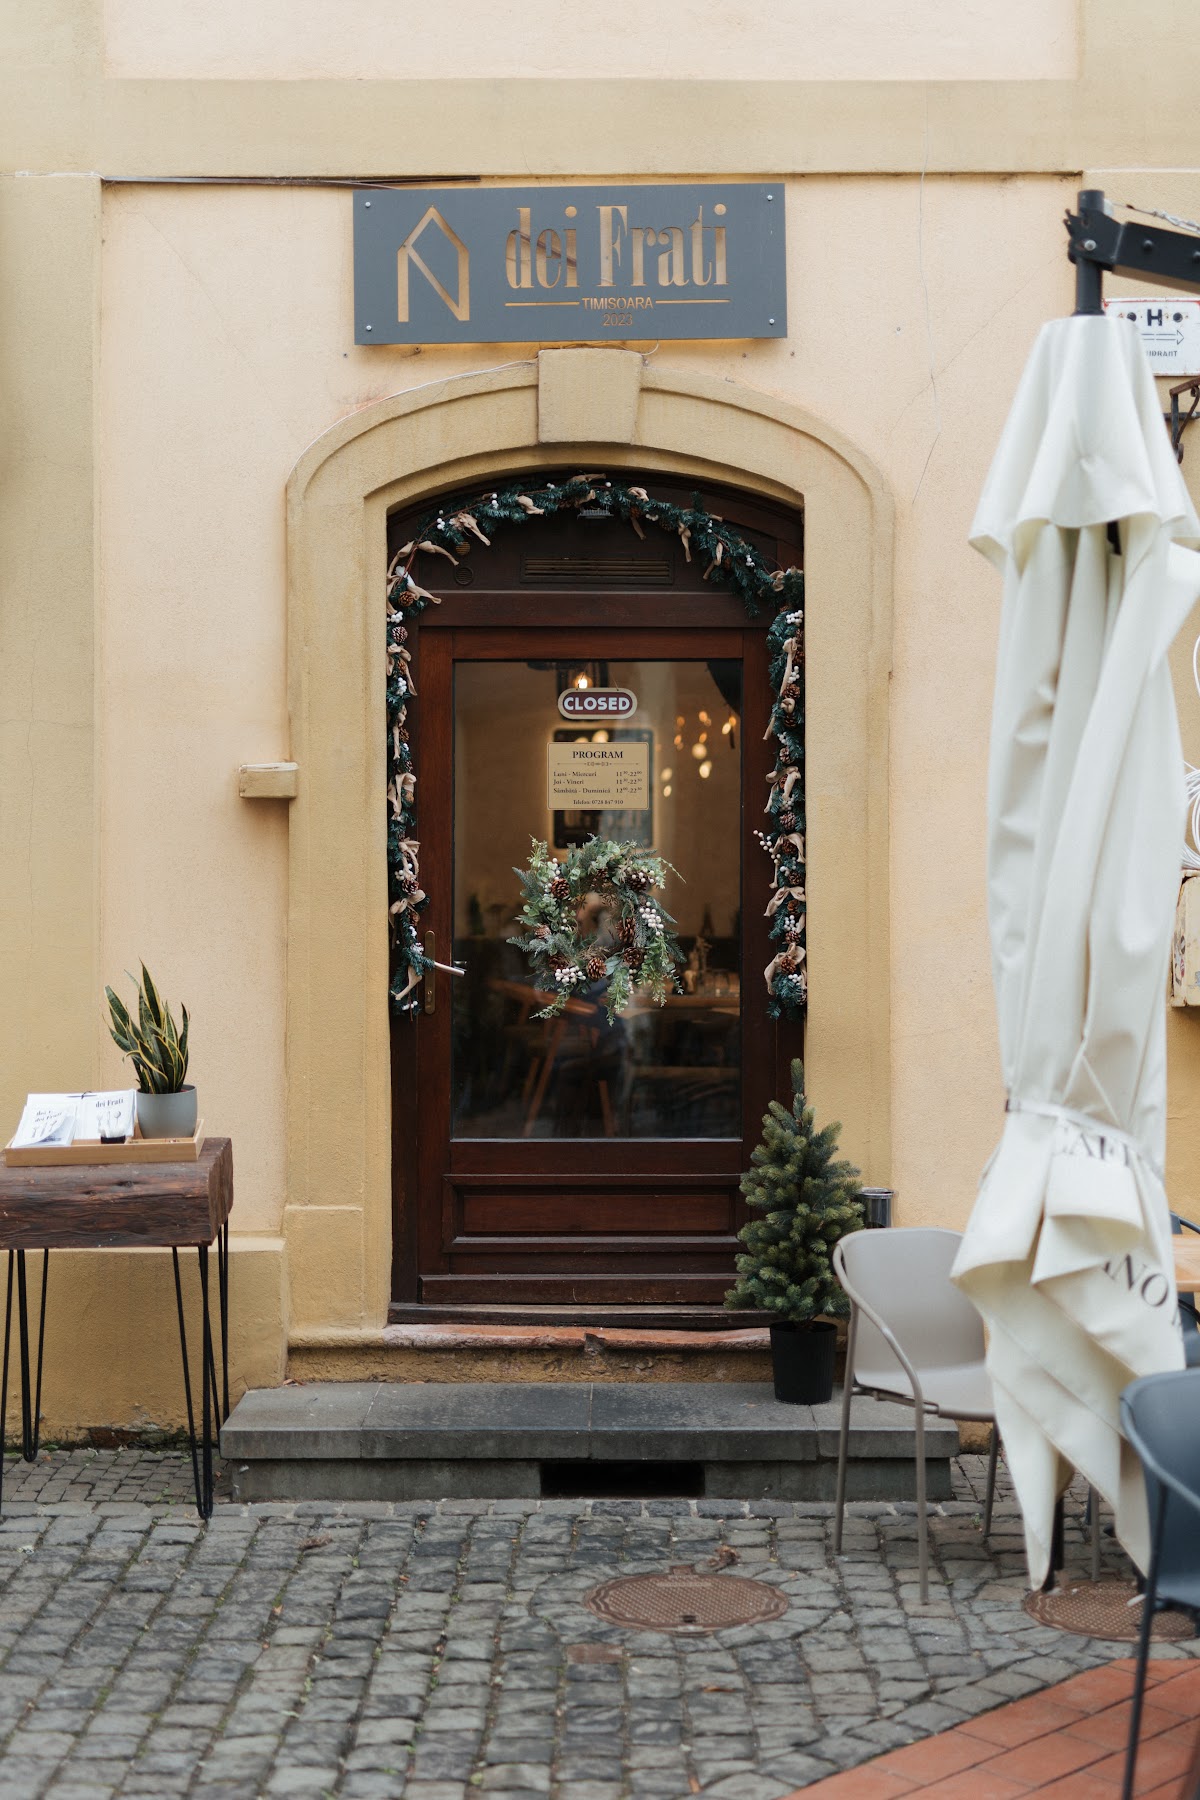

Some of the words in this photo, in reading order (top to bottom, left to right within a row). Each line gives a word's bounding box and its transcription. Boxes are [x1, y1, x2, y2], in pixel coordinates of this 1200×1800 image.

[505, 205, 580, 289] dei
[595, 203, 729, 287] Frati
[582, 297, 654, 310] TIMISOARA
[603, 312, 633, 326] 2023
[1147, 309, 1163, 326] H
[563, 697, 630, 711] CLOSED
[572, 751, 624, 759] PROGRAM
